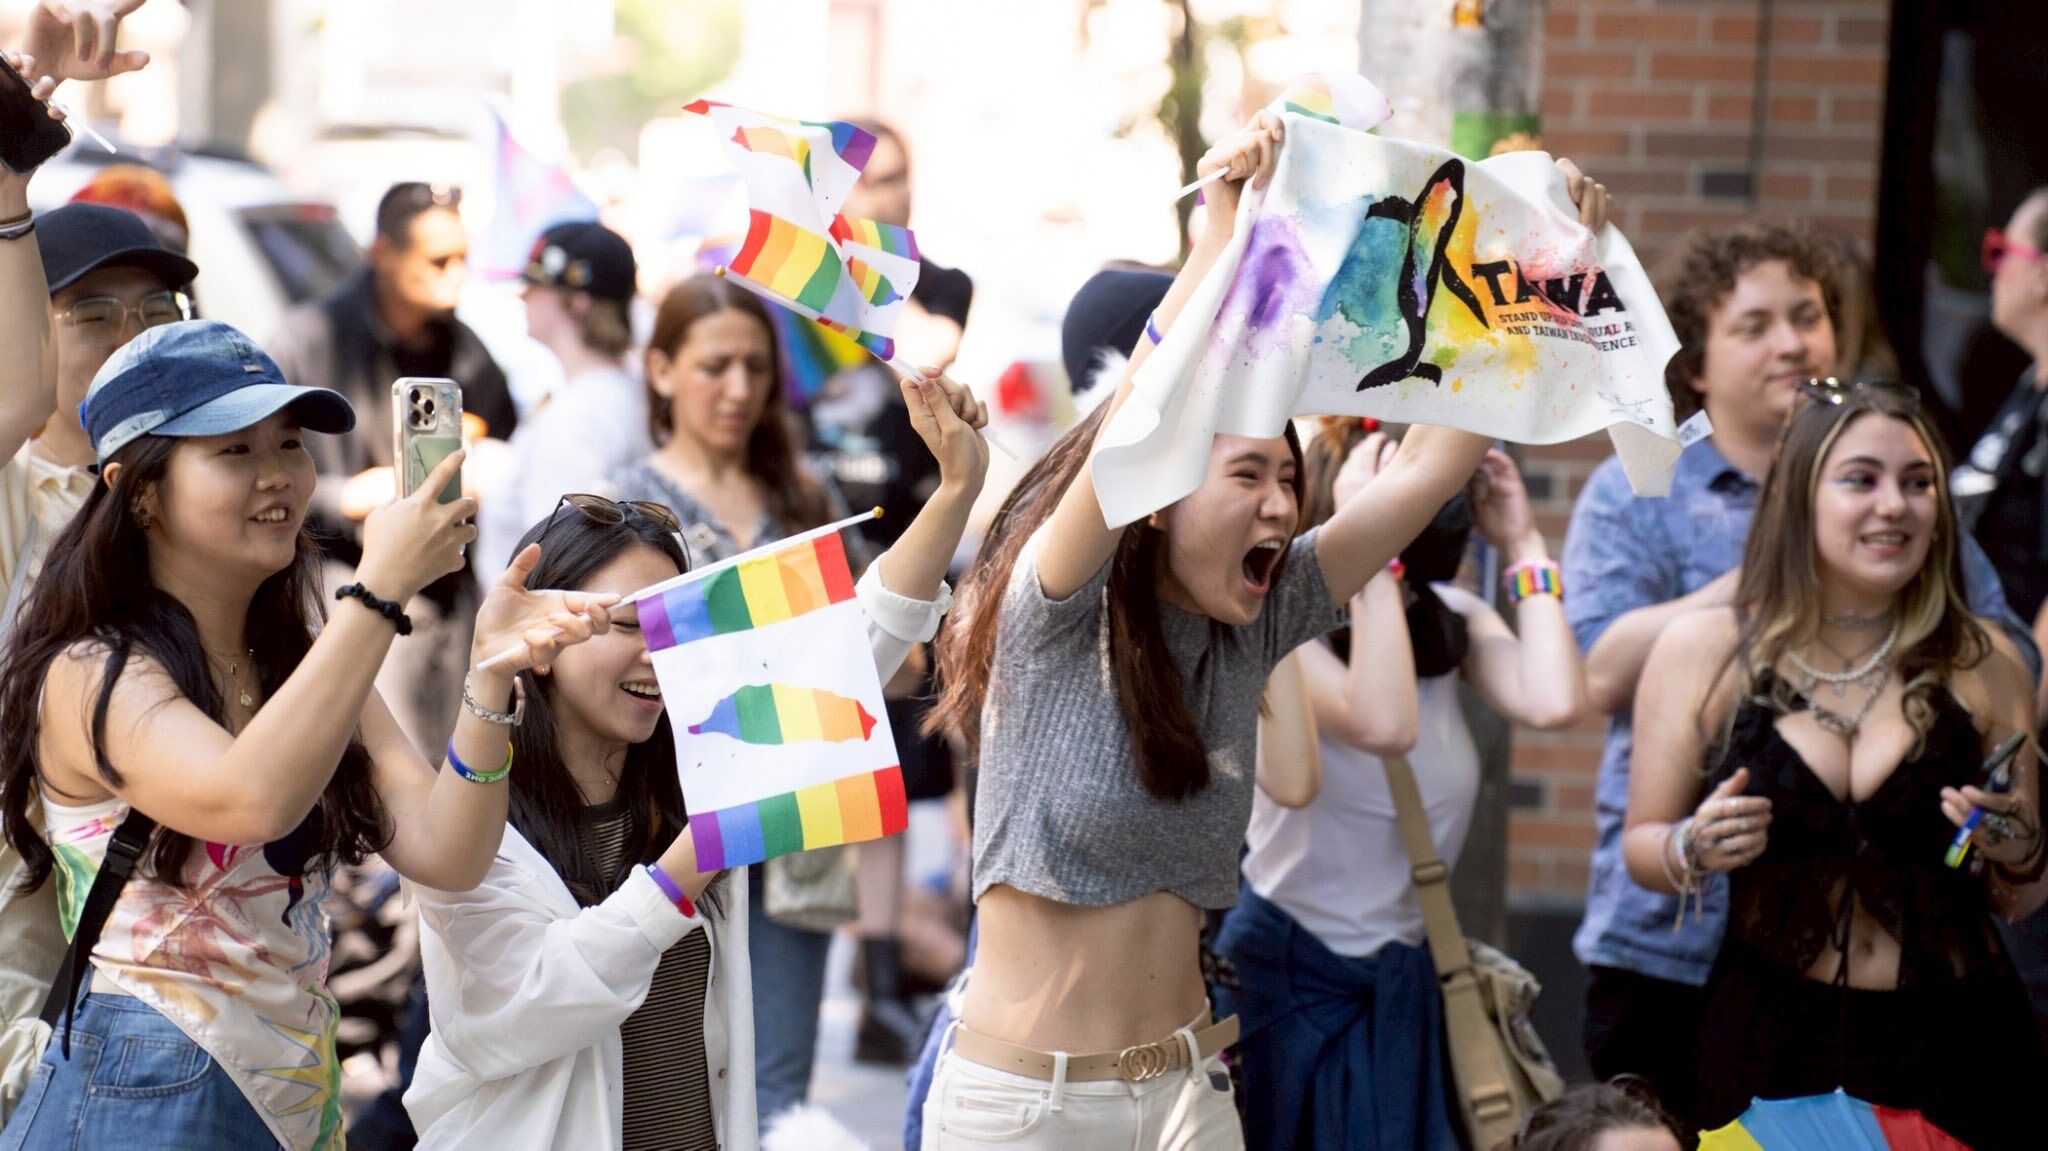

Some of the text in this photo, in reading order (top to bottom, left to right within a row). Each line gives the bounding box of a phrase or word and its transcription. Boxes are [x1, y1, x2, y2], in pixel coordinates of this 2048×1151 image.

[1498, 312, 1538, 323] STAND
[1507, 325, 1531, 336] AND
[1532, 325, 1569, 340] TAIWAN
